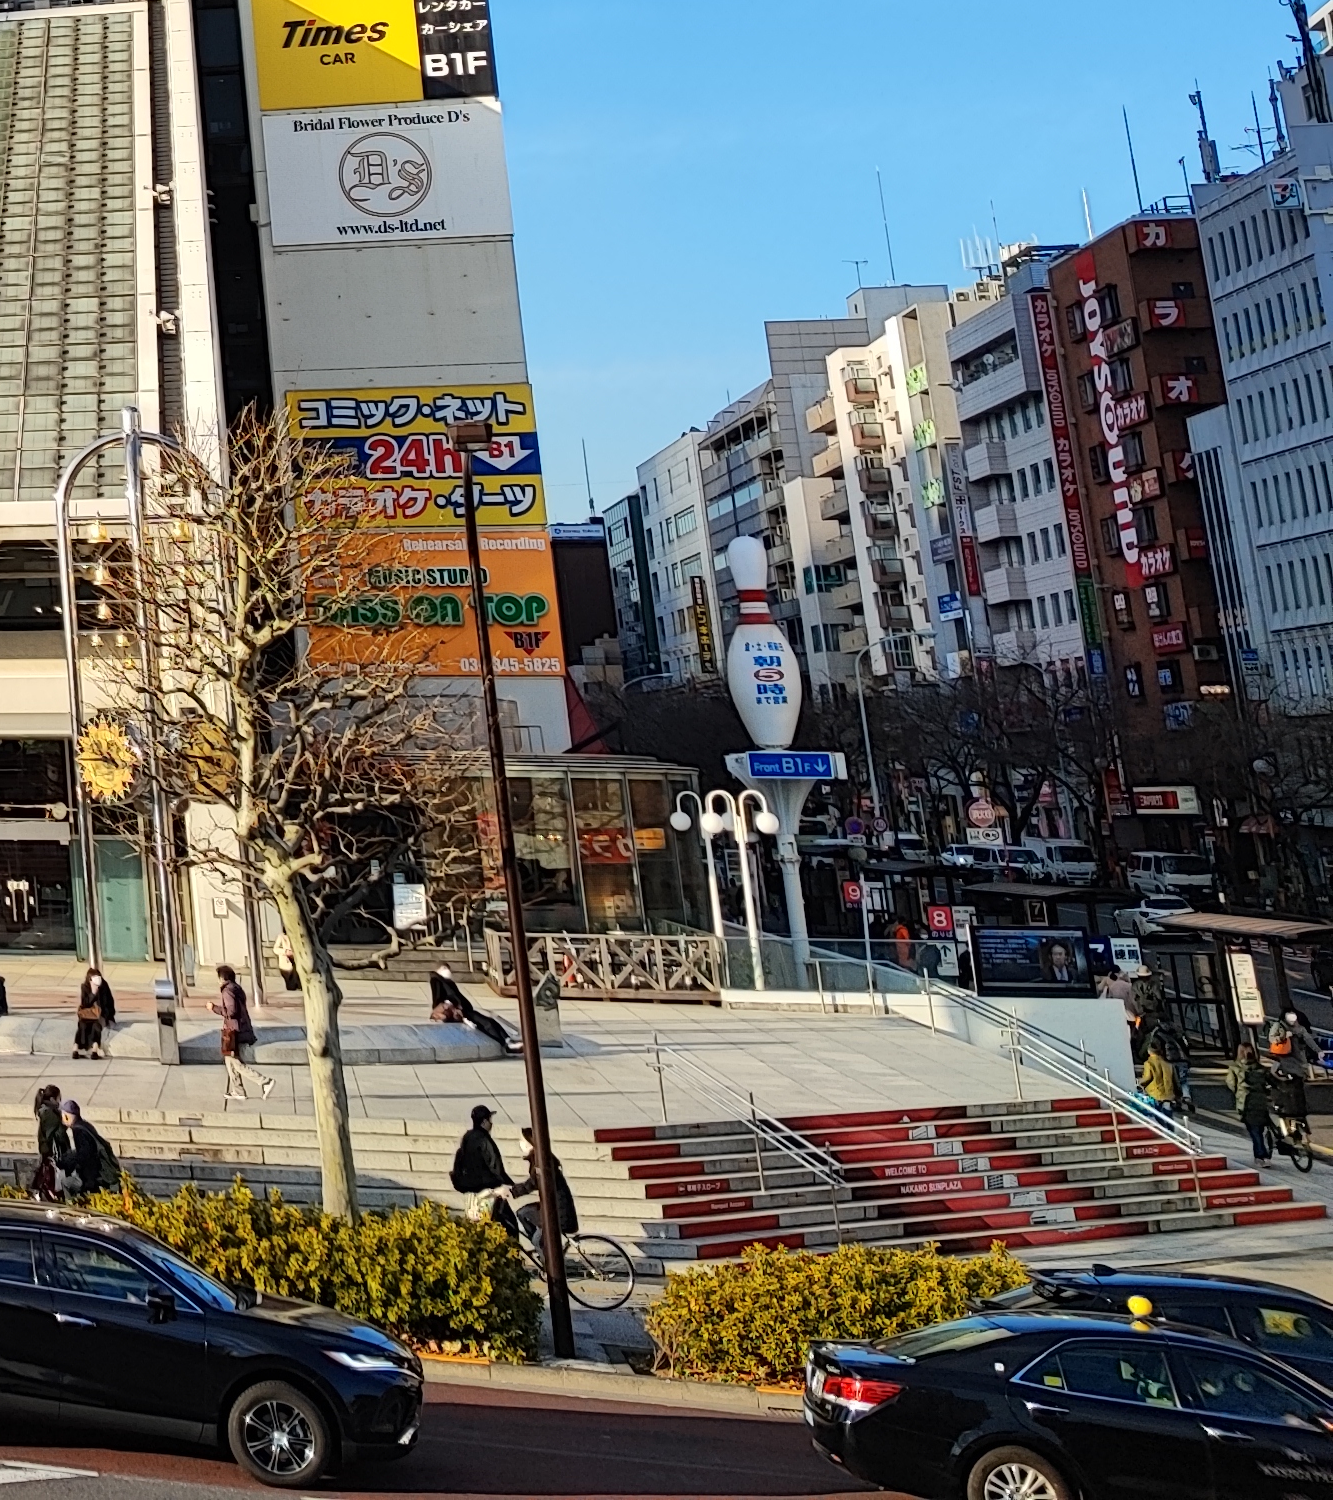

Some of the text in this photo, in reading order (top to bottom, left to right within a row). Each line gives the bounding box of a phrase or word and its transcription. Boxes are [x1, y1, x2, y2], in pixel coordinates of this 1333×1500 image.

[281, 20, 389, 49] Times
[421, 19, 488, 35] カーシェア
[319, 52, 356, 66] CAR
[425, 51, 488, 77] B1F
[292, 110, 470, 133] Bridal Flower Produce D's
[336, 218, 447, 236] www.ds-ltd.net
[1034, 299, 1055, 357] カラオケ
[1044, 368, 1065, 427] JOYSOUND
[298, 393, 526, 428] コミック・ネット
[1116, 397, 1146, 427] カラオケ
[367, 435, 464, 477] 24h
[488, 440, 515, 458] B1
[1057, 437, 1078, 496] カラオケ
[403, 537, 467, 552] Rehearsal
[1067, 508, 1088, 569] JOYSOUND
[1140, 547, 1171, 577] カラオケ
[513, 631, 543, 649] B1F
[460, 657, 561, 673] 03-345-5825
[757, 669, 782, 682] 5
[754, 762, 780, 773] Front
[848, 885, 860, 899] 9
[933, 911, 946, 927] 8
[884, 1165, 927, 1177] WELCOME TO
